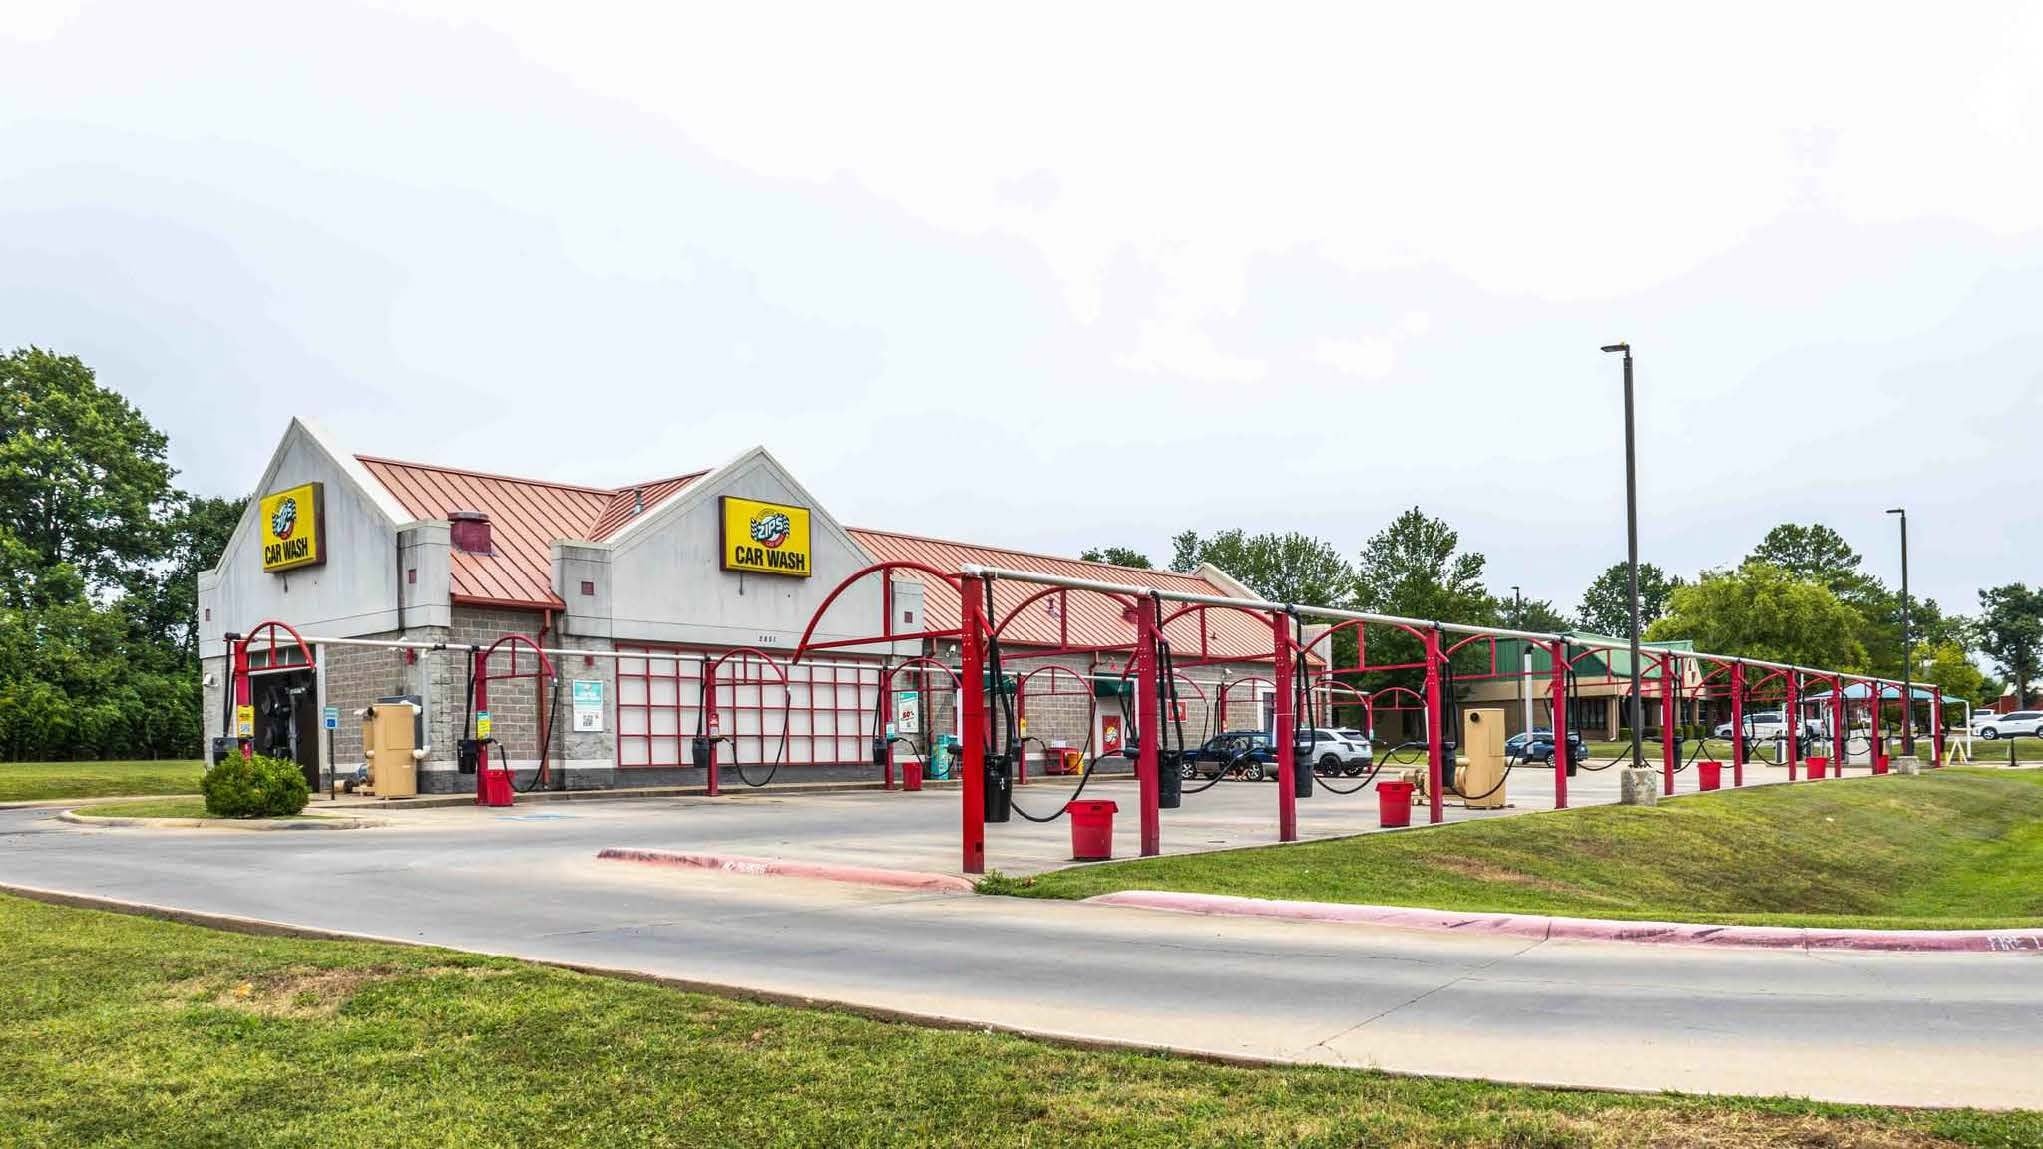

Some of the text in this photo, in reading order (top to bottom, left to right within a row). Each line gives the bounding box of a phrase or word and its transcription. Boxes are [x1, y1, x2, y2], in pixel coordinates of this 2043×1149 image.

[757, 517, 784, 539] ZIPS
[265, 537, 308, 564] CAR WASH
[735, 546, 805, 570] CAR WASH
[1986, 935, 2027, 951] FIRE
